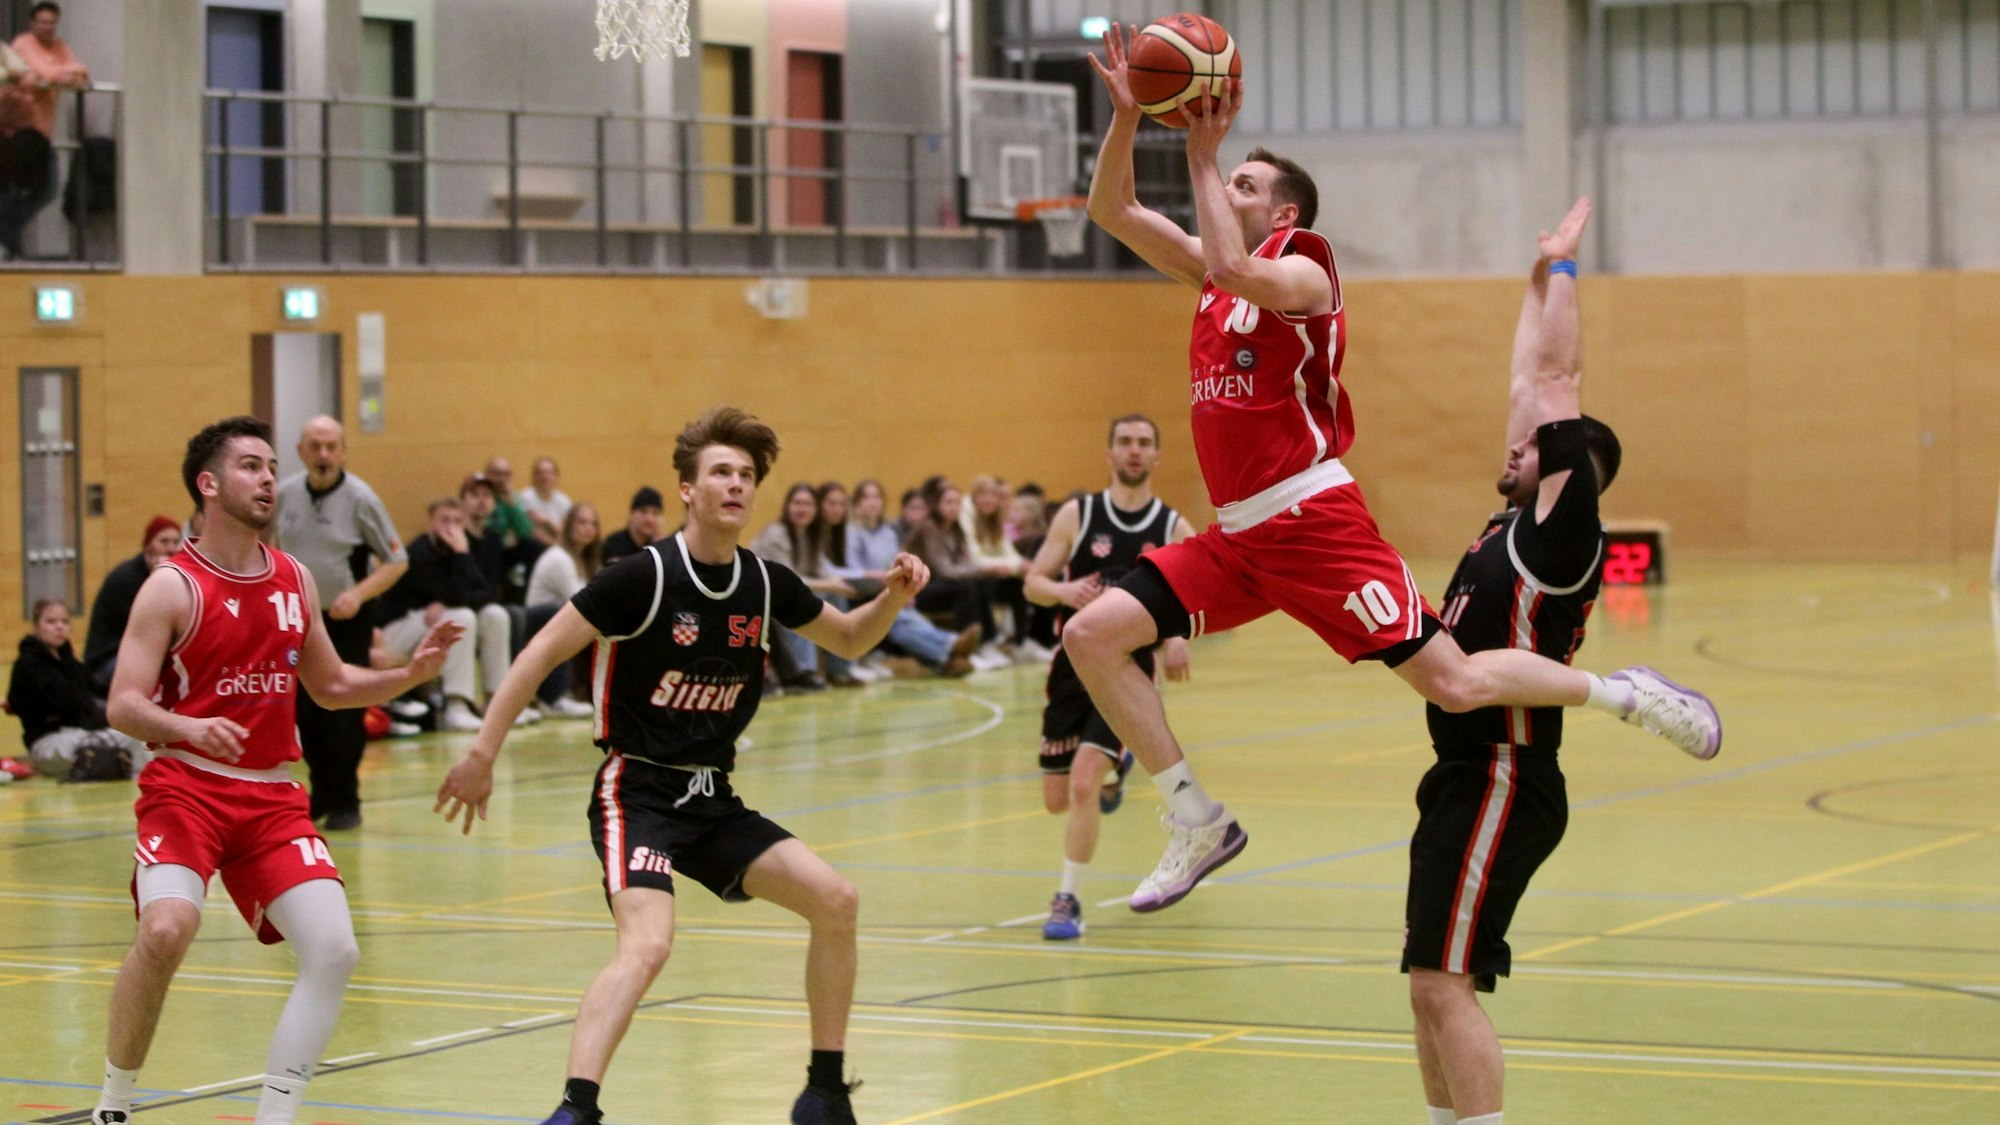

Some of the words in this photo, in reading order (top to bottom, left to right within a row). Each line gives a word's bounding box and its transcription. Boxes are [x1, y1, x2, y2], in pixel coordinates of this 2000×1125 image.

[1223, 296, 1260, 335] 10
[1190, 363, 1226, 379] ETER
[1603, 542, 1651, 585] 22
[268, 591, 304, 633] 14
[1342, 579, 1401, 634] 10
[728, 615, 762, 647] 54
[291, 836, 336, 868] 14
